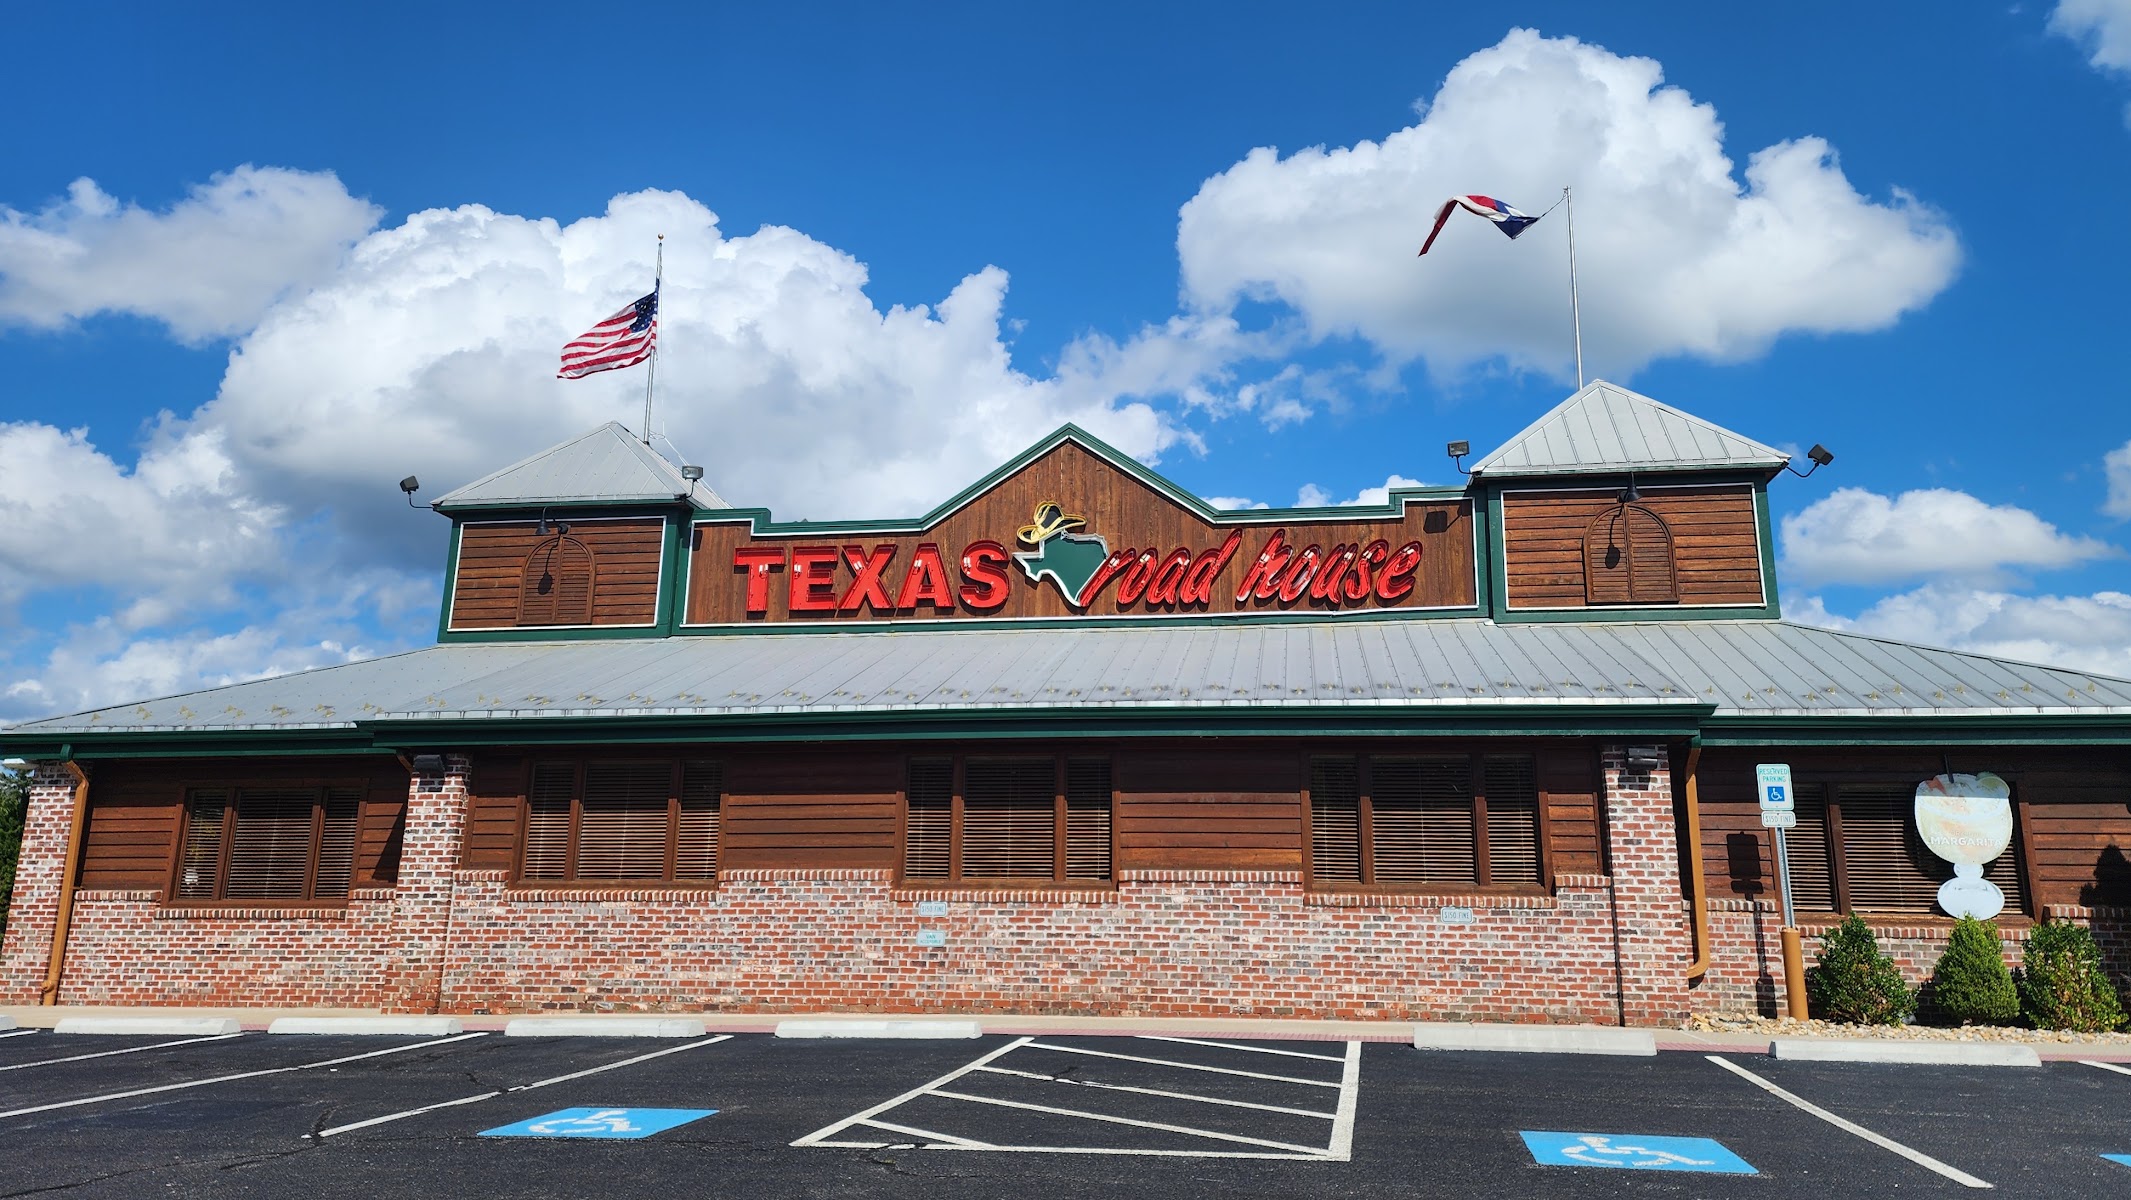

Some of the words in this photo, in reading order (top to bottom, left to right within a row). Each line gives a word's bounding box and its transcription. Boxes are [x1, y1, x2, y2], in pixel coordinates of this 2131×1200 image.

[734, 539, 1011, 612] TEXAS
[1078, 528, 1243, 607] road
[1235, 528, 1423, 604] house
[1759, 767, 1788, 775] RESERVED
[1762, 775, 1787, 783] PARKING
[1765, 815, 1779, 823] $150
[1780, 815, 1792, 823] FINE
[1930, 836, 2003, 847] MARGARITA
[934, 905, 945, 913] FINE
